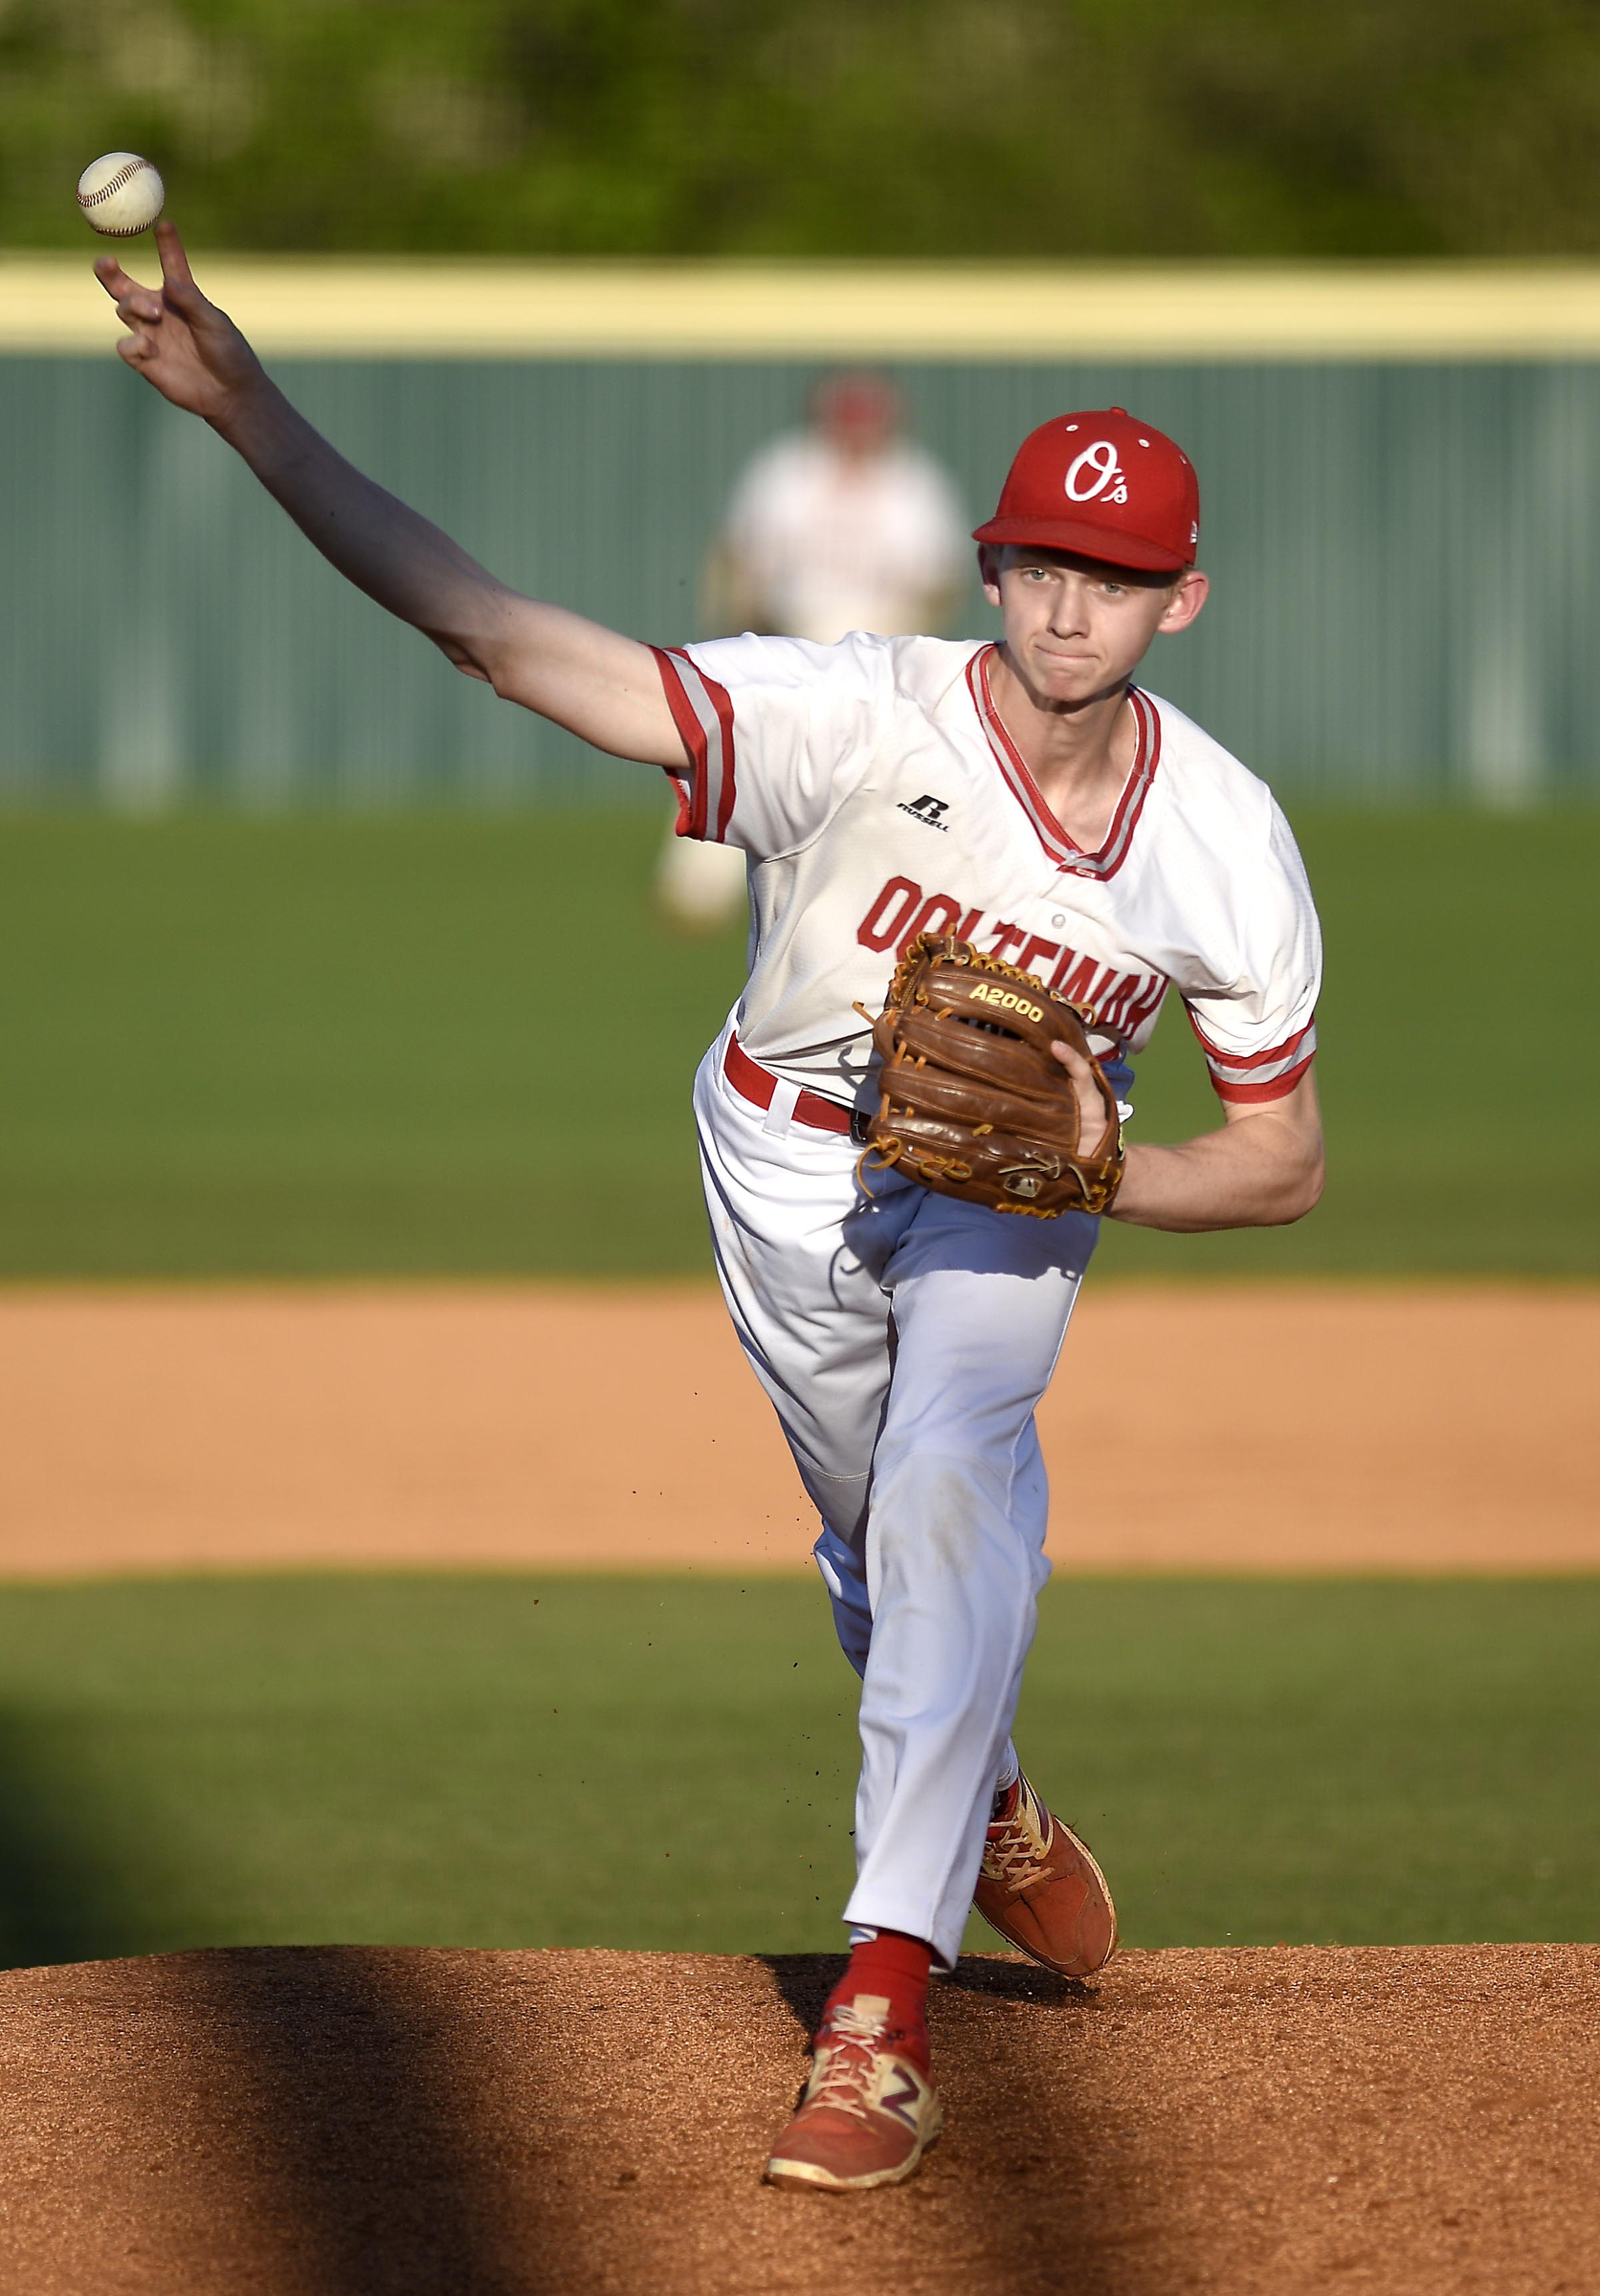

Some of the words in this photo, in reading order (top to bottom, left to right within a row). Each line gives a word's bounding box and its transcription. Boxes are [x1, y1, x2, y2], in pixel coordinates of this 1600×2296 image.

[1064, 441, 1128, 504] O's
[897, 803, 949, 832] RUSSELL
[969, 983, 1045, 1024] A2000
